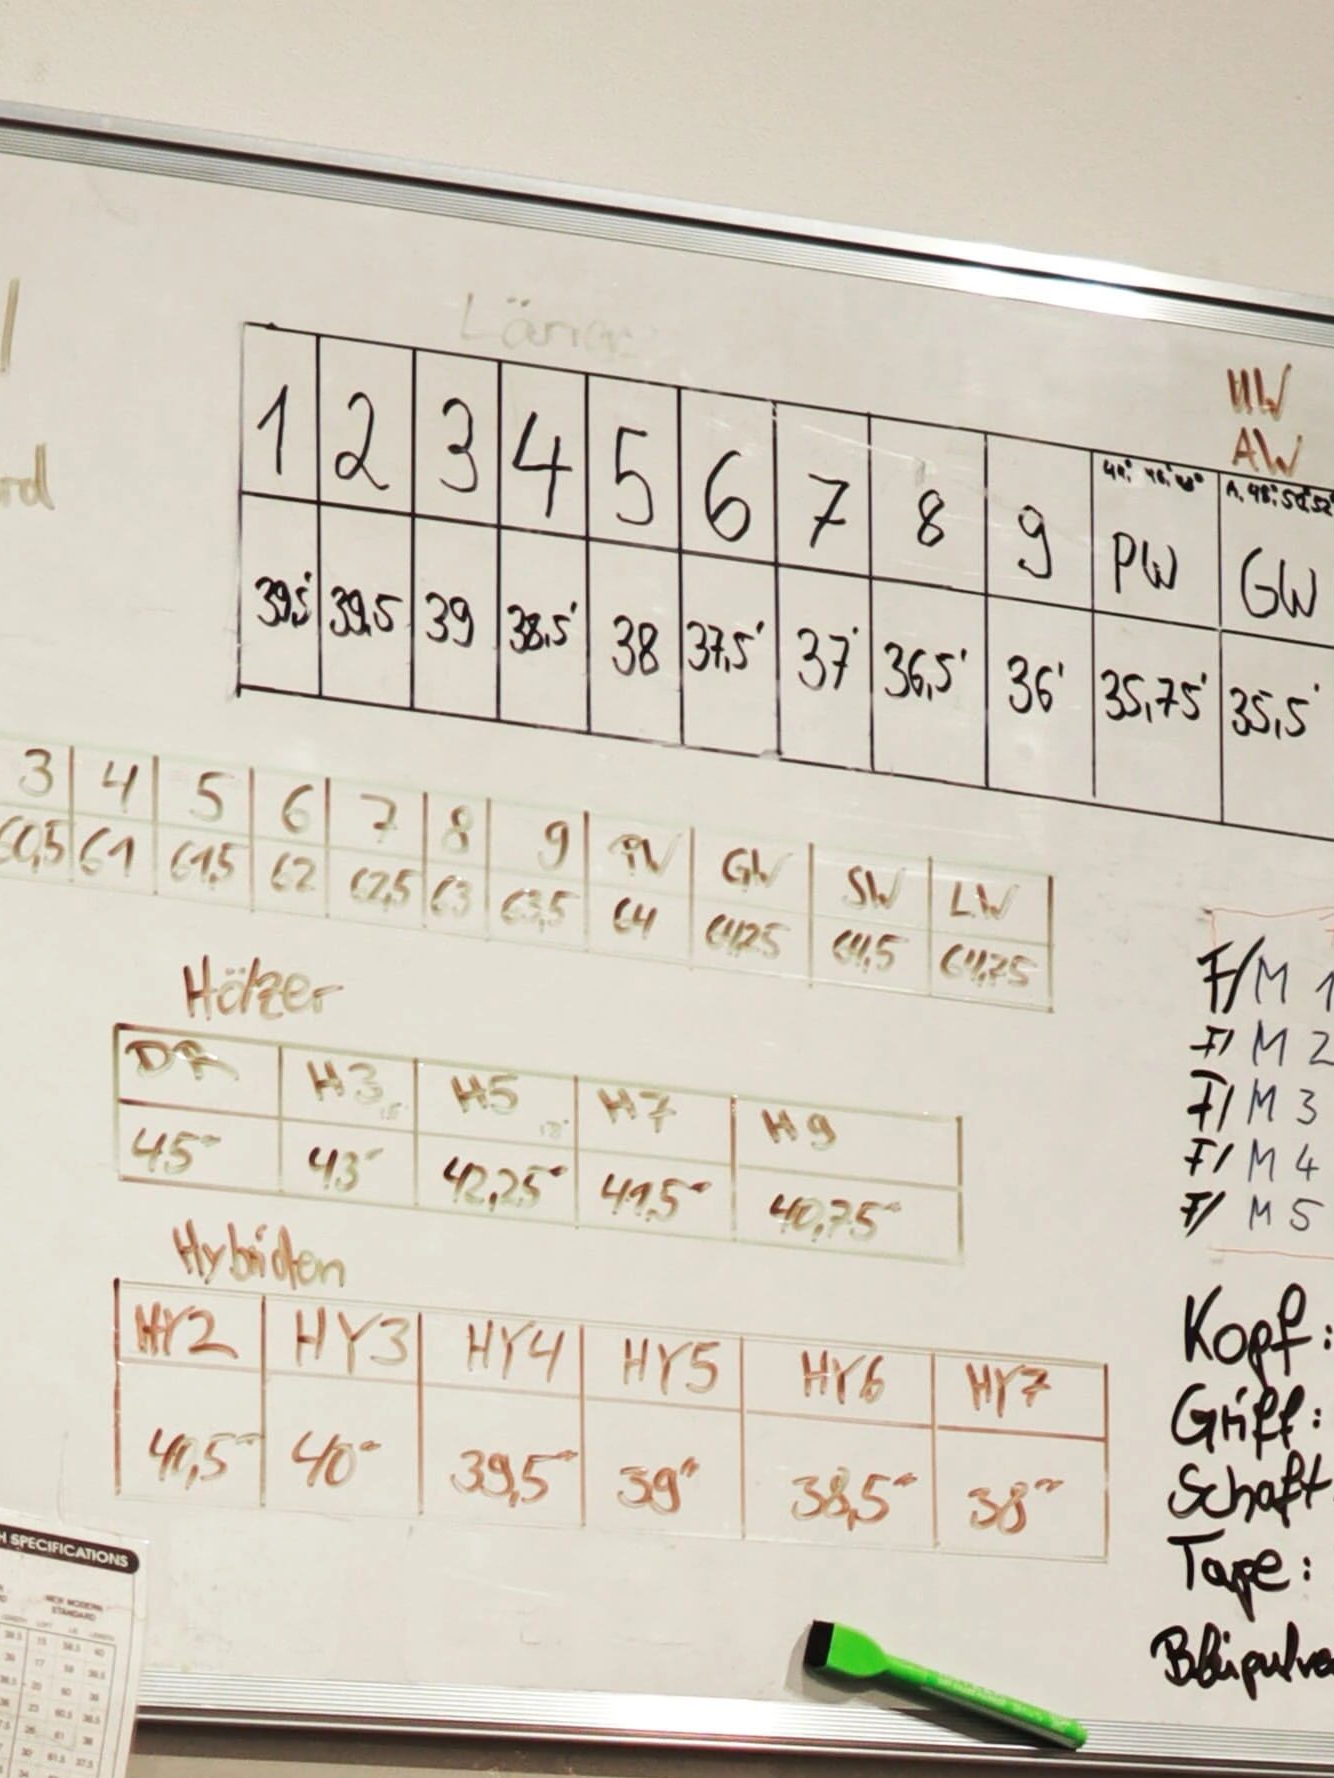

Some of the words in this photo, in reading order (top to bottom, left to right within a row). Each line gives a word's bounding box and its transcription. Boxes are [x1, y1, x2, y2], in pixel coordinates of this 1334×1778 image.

[1232, 426, 1304, 477] AW
[257, 385, 290, 476] 1
[334, 392, 390, 492] 2
[440, 397, 479, 493] 3
[512, 412, 573, 518] 4
[614, 426, 654, 526] 5
[704, 450, 751, 542] 6
[808, 473, 850, 549] 7
[916, 489, 945, 547] 8
[1017, 504, 1053, 579] 9
[1112, 532, 1179, 594] PW
[1240, 547, 1318, 619] GW
[424, 593, 475, 648] 39
[612, 615, 658, 676] 38
[18, 747, 54, 798] 3
[101, 760, 139, 814] 4
[189, 771, 235, 822] 5
[281, 784, 314, 833] 6
[360, 793, 398, 844] 7
[441, 803, 473, 855] 8
[538, 820, 570, 872] 9
[608, 832, 682, 876] PW
[721, 847, 793, 892] GW
[843, 866, 906, 911] SW
[949, 881, 1020, 921] LW
[79, 826, 136, 878] 61
[271, 851, 317, 894] 62
[613, 897, 658, 939] 64
[183, 954, 344, 1021] Hölzer
[307, 1059, 384, 1101] H3
[451, 1073, 519, 1115] H5
[598, 1087, 677, 1134] H7
[761, 1108, 838, 1151] H9
[1296, 1088, 1318, 1125] 3
[1295, 1143, 1320, 1181] 4
[1289, 1198, 1325, 1231] 5
[172, 1218, 346, 1289] Hybriden
[135, 1301, 240, 1359] HY2
[296, 1307, 411, 1374] HY3
[468, 1320, 565, 1382] HY4
[623, 1337, 721, 1395] HY5
[801, 1350, 885, 1405] HY6
[966, 1362, 1052, 1418] HY7
[10, 1533, 129, 1568] SPECIFICATIONS
